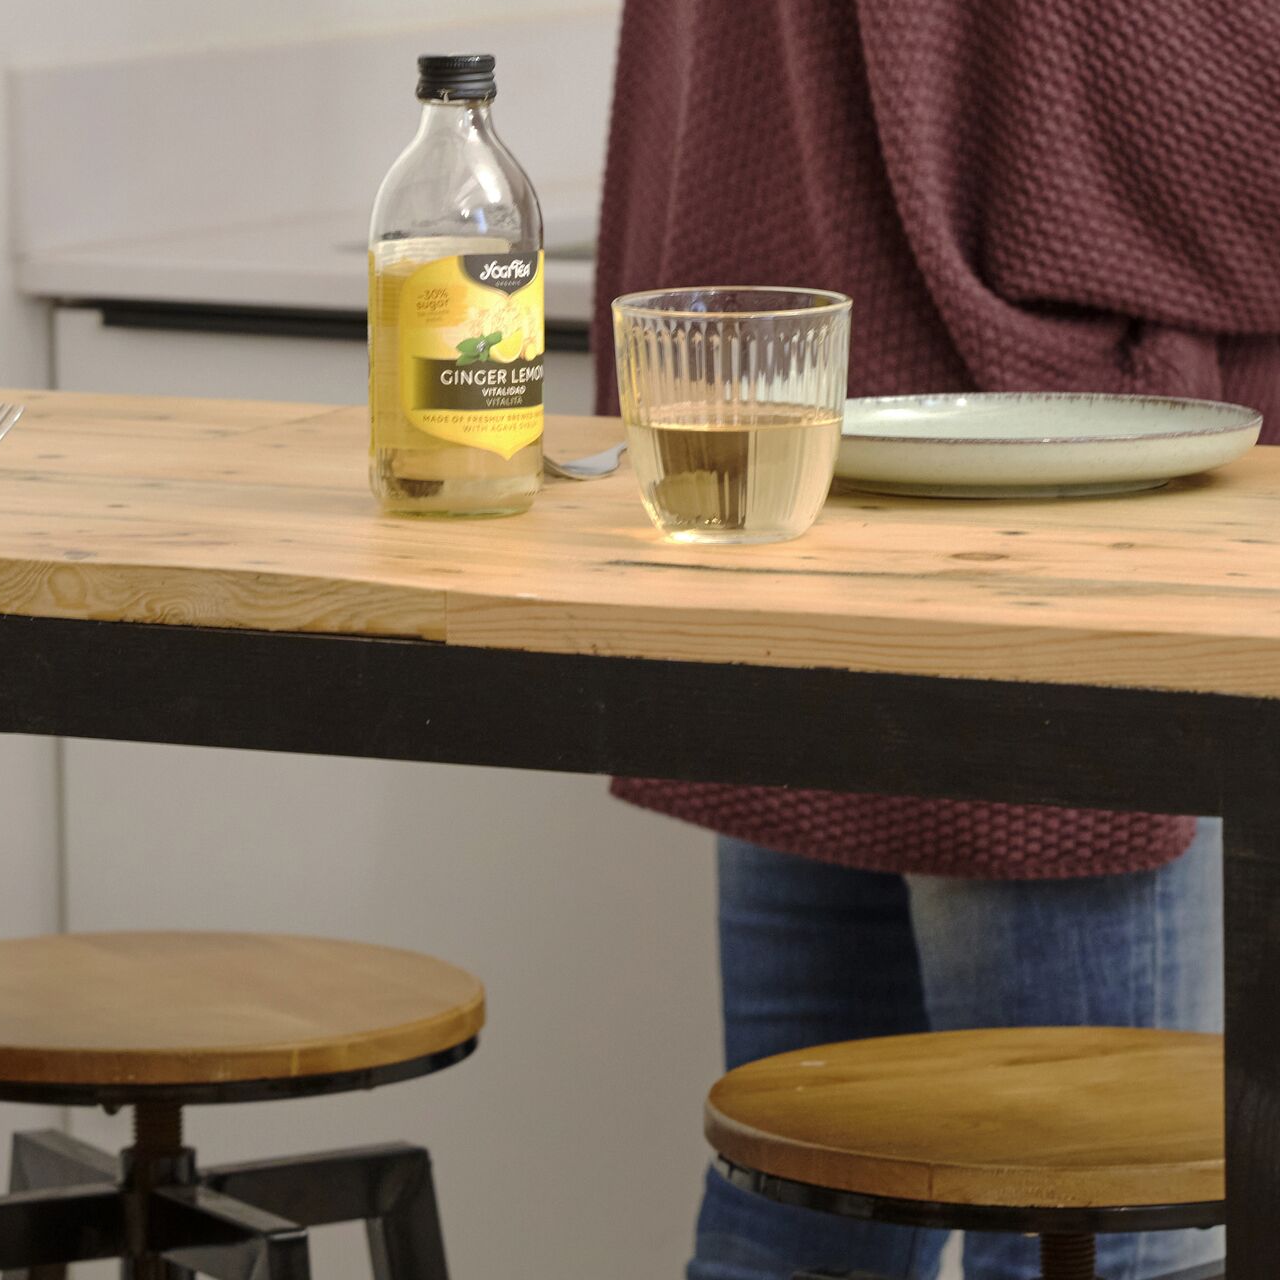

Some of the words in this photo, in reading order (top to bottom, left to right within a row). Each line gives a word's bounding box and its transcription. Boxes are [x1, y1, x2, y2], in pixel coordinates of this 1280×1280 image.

[440, 369, 507, 386] GINGER
[481, 385, 527, 397] VITALIDAD
[423, 414, 449, 424] MADE
[452, 414, 464, 424] OF
